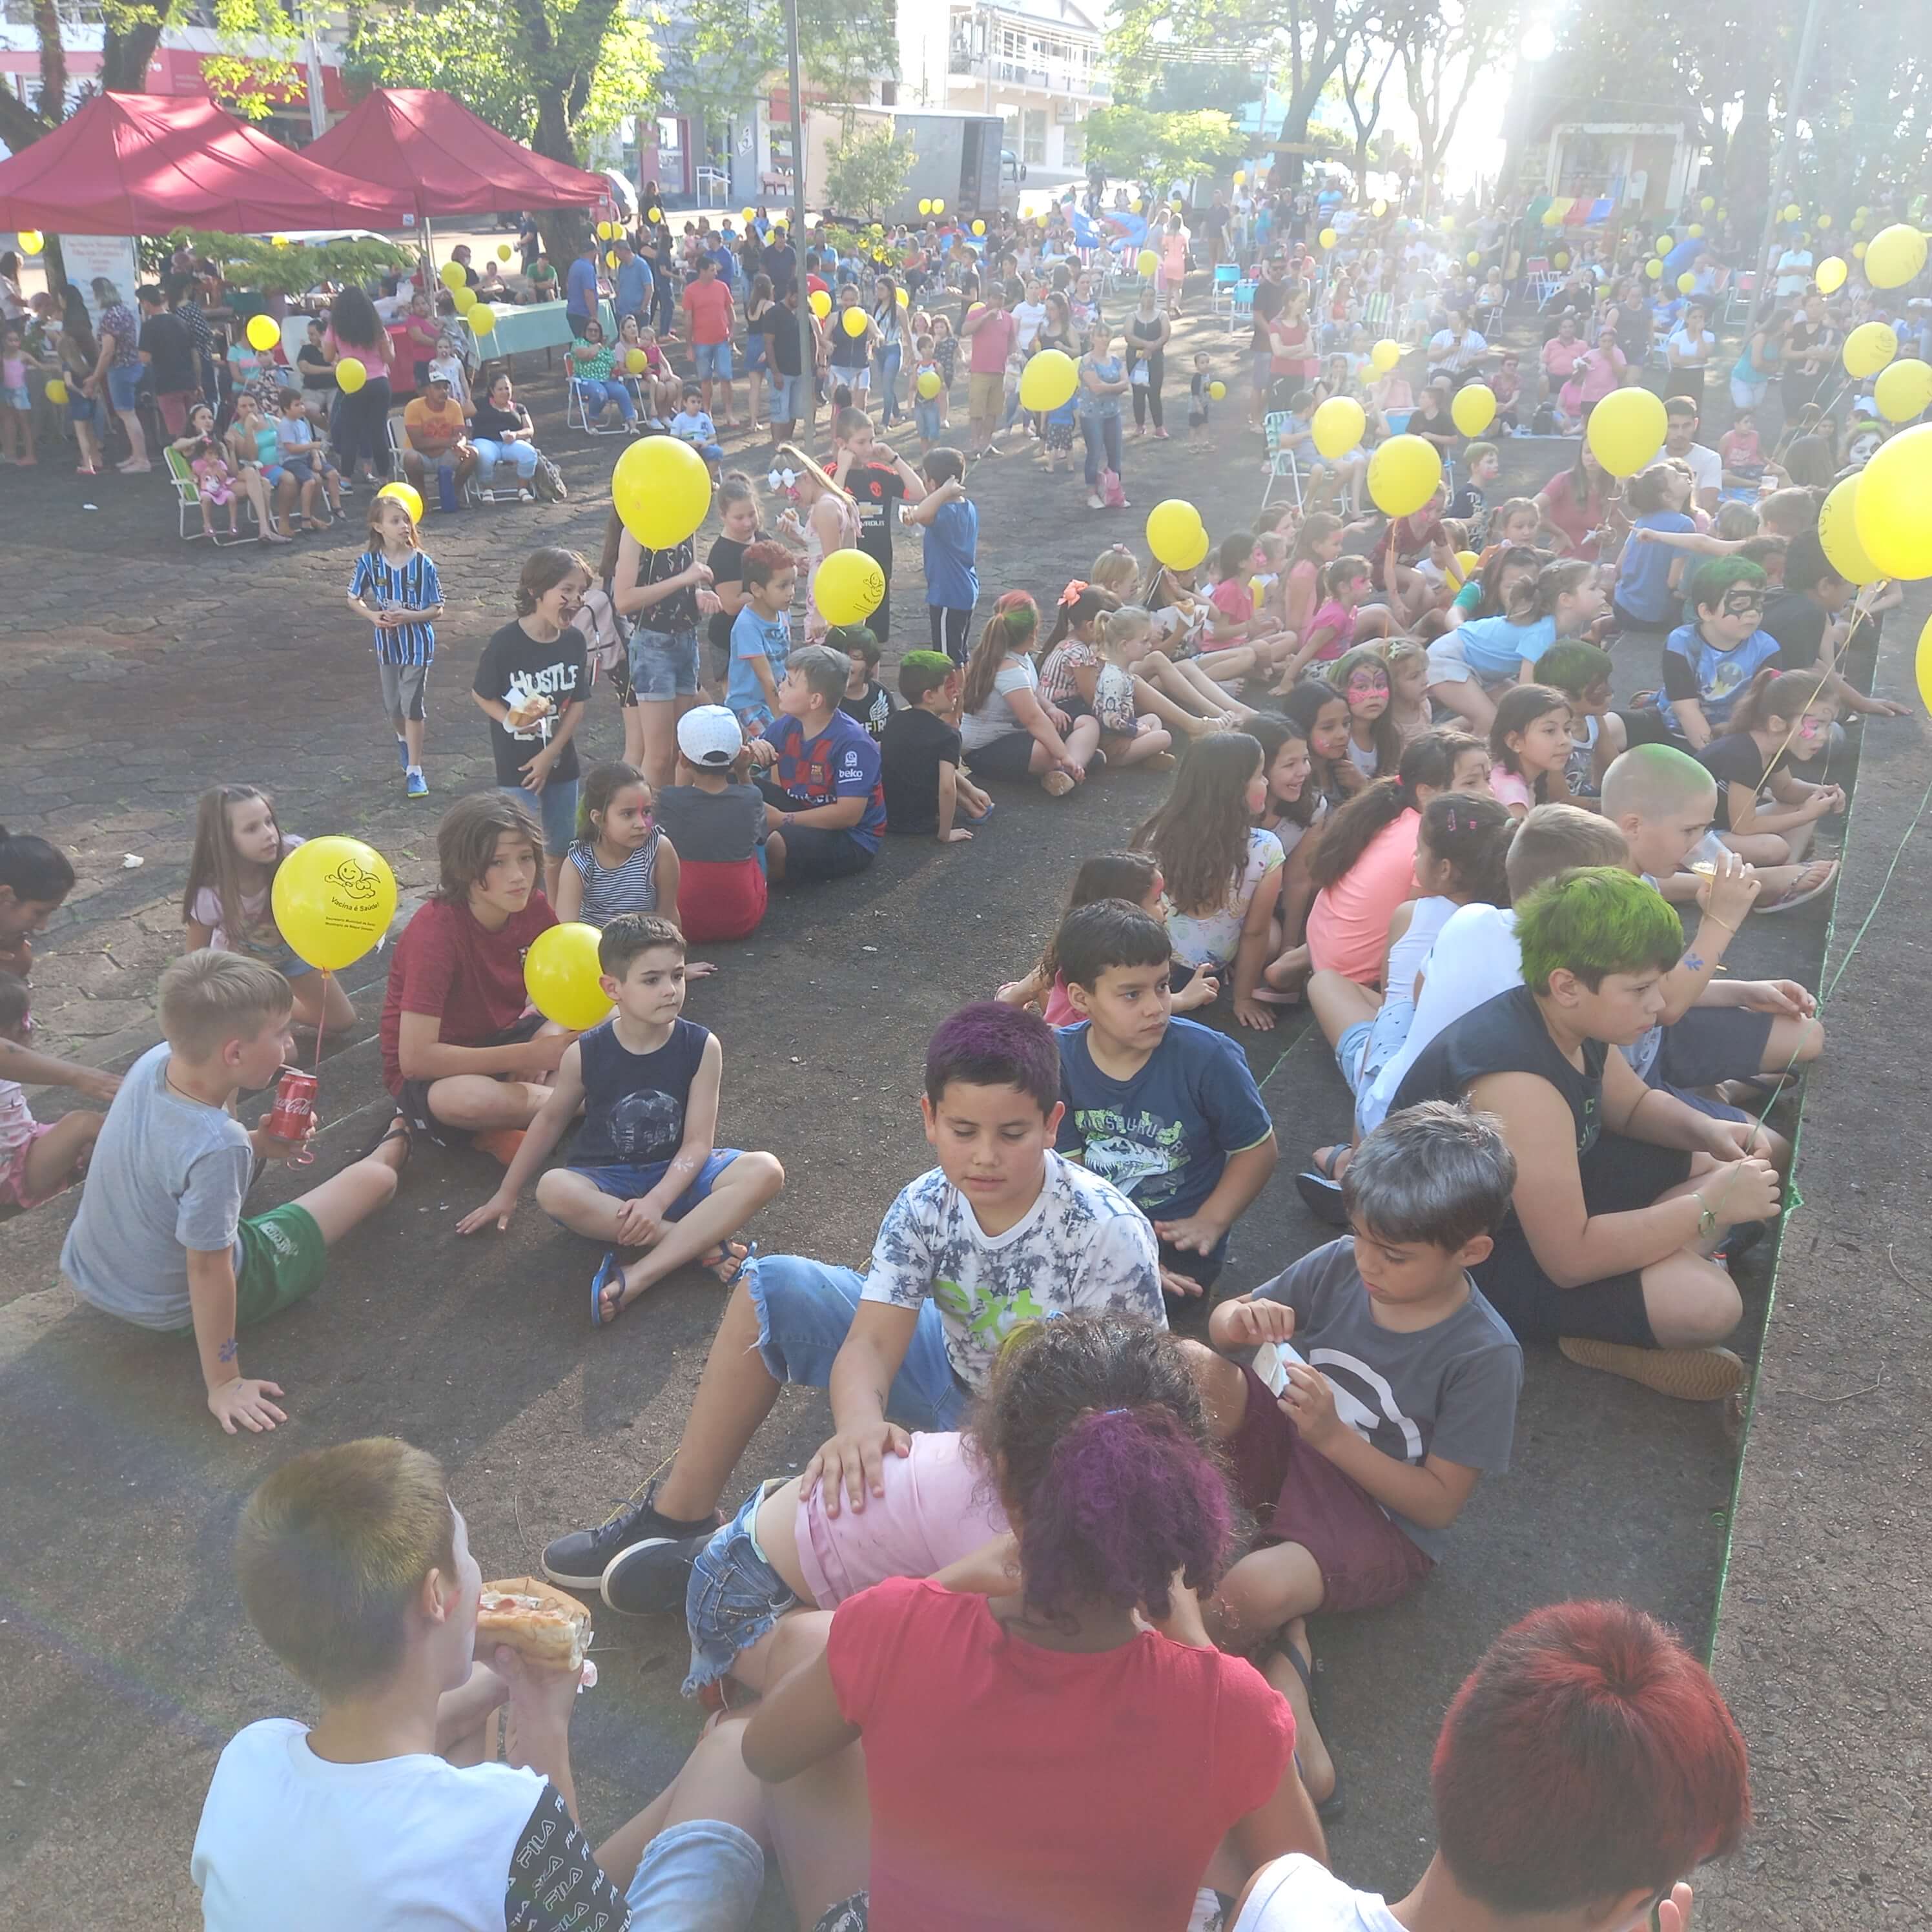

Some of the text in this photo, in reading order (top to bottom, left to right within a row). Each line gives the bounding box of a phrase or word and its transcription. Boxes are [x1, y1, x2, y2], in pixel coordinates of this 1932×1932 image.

[509, 662, 579, 697] HUSTLE
[839, 768, 863, 779] beko
[331, 896, 353, 910] Vacina
[517, 1820, 556, 1869] FILA
[543, 1867, 583, 1911] FILA
[591, 1869, 605, 1896] FILA
